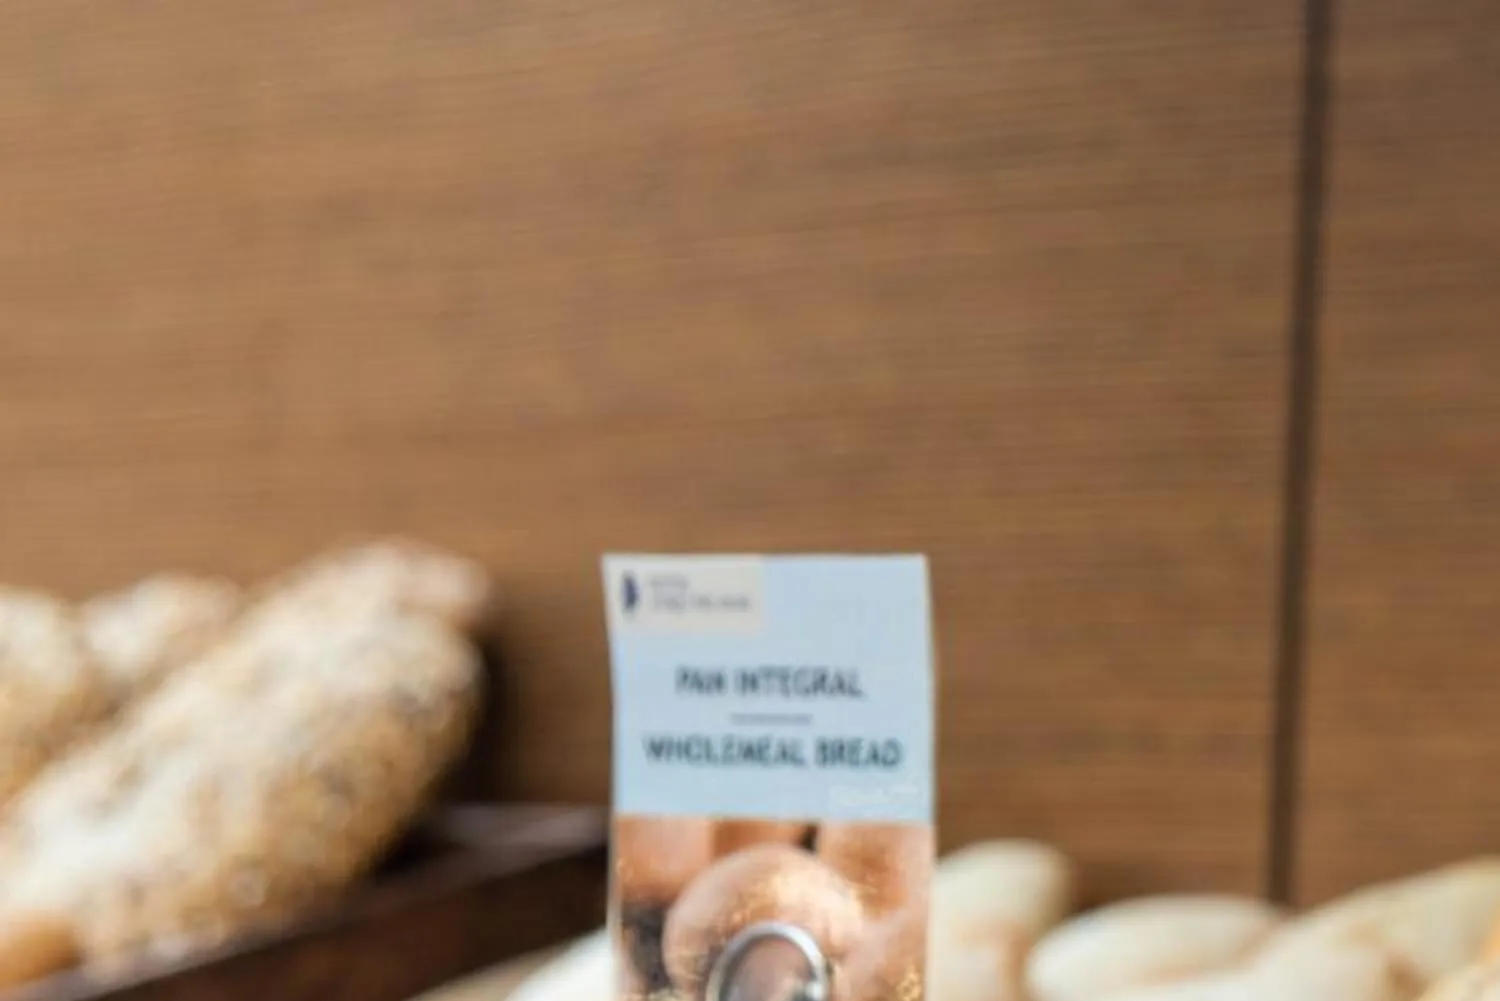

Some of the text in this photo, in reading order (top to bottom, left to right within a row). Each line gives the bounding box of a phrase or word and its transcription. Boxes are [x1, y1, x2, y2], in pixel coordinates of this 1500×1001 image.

[675, 666, 865, 698] PAN INTEGRAL
[643, 735, 905, 768] WHOLEMEAL BREAD
